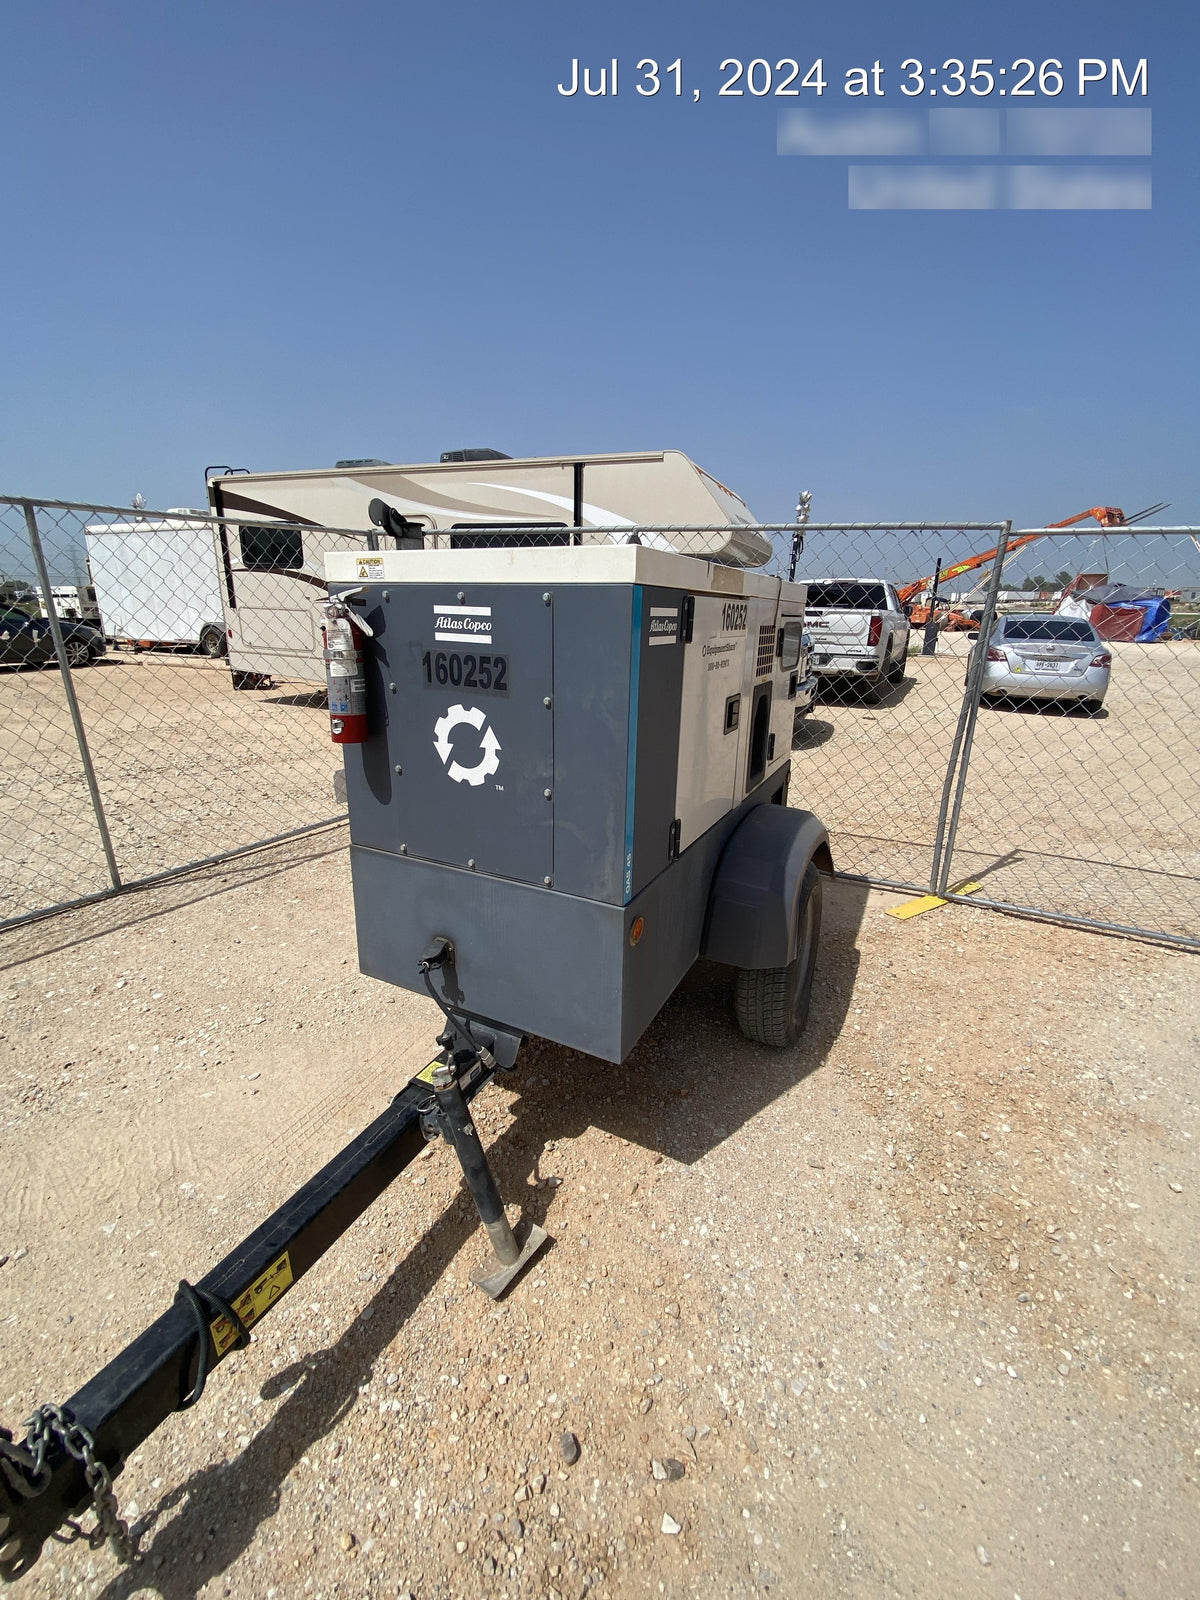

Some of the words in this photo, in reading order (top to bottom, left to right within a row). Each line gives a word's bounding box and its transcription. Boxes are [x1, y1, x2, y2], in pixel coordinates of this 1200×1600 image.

[435, 616, 463, 629] Atlas
[463, 617, 492, 632] Copco
[649, 619, 664, 632] Atlas
[664, 619, 678, 634] Copco
[722, 602, 748, 631] 160252
[422, 651, 508, 691] 160252
